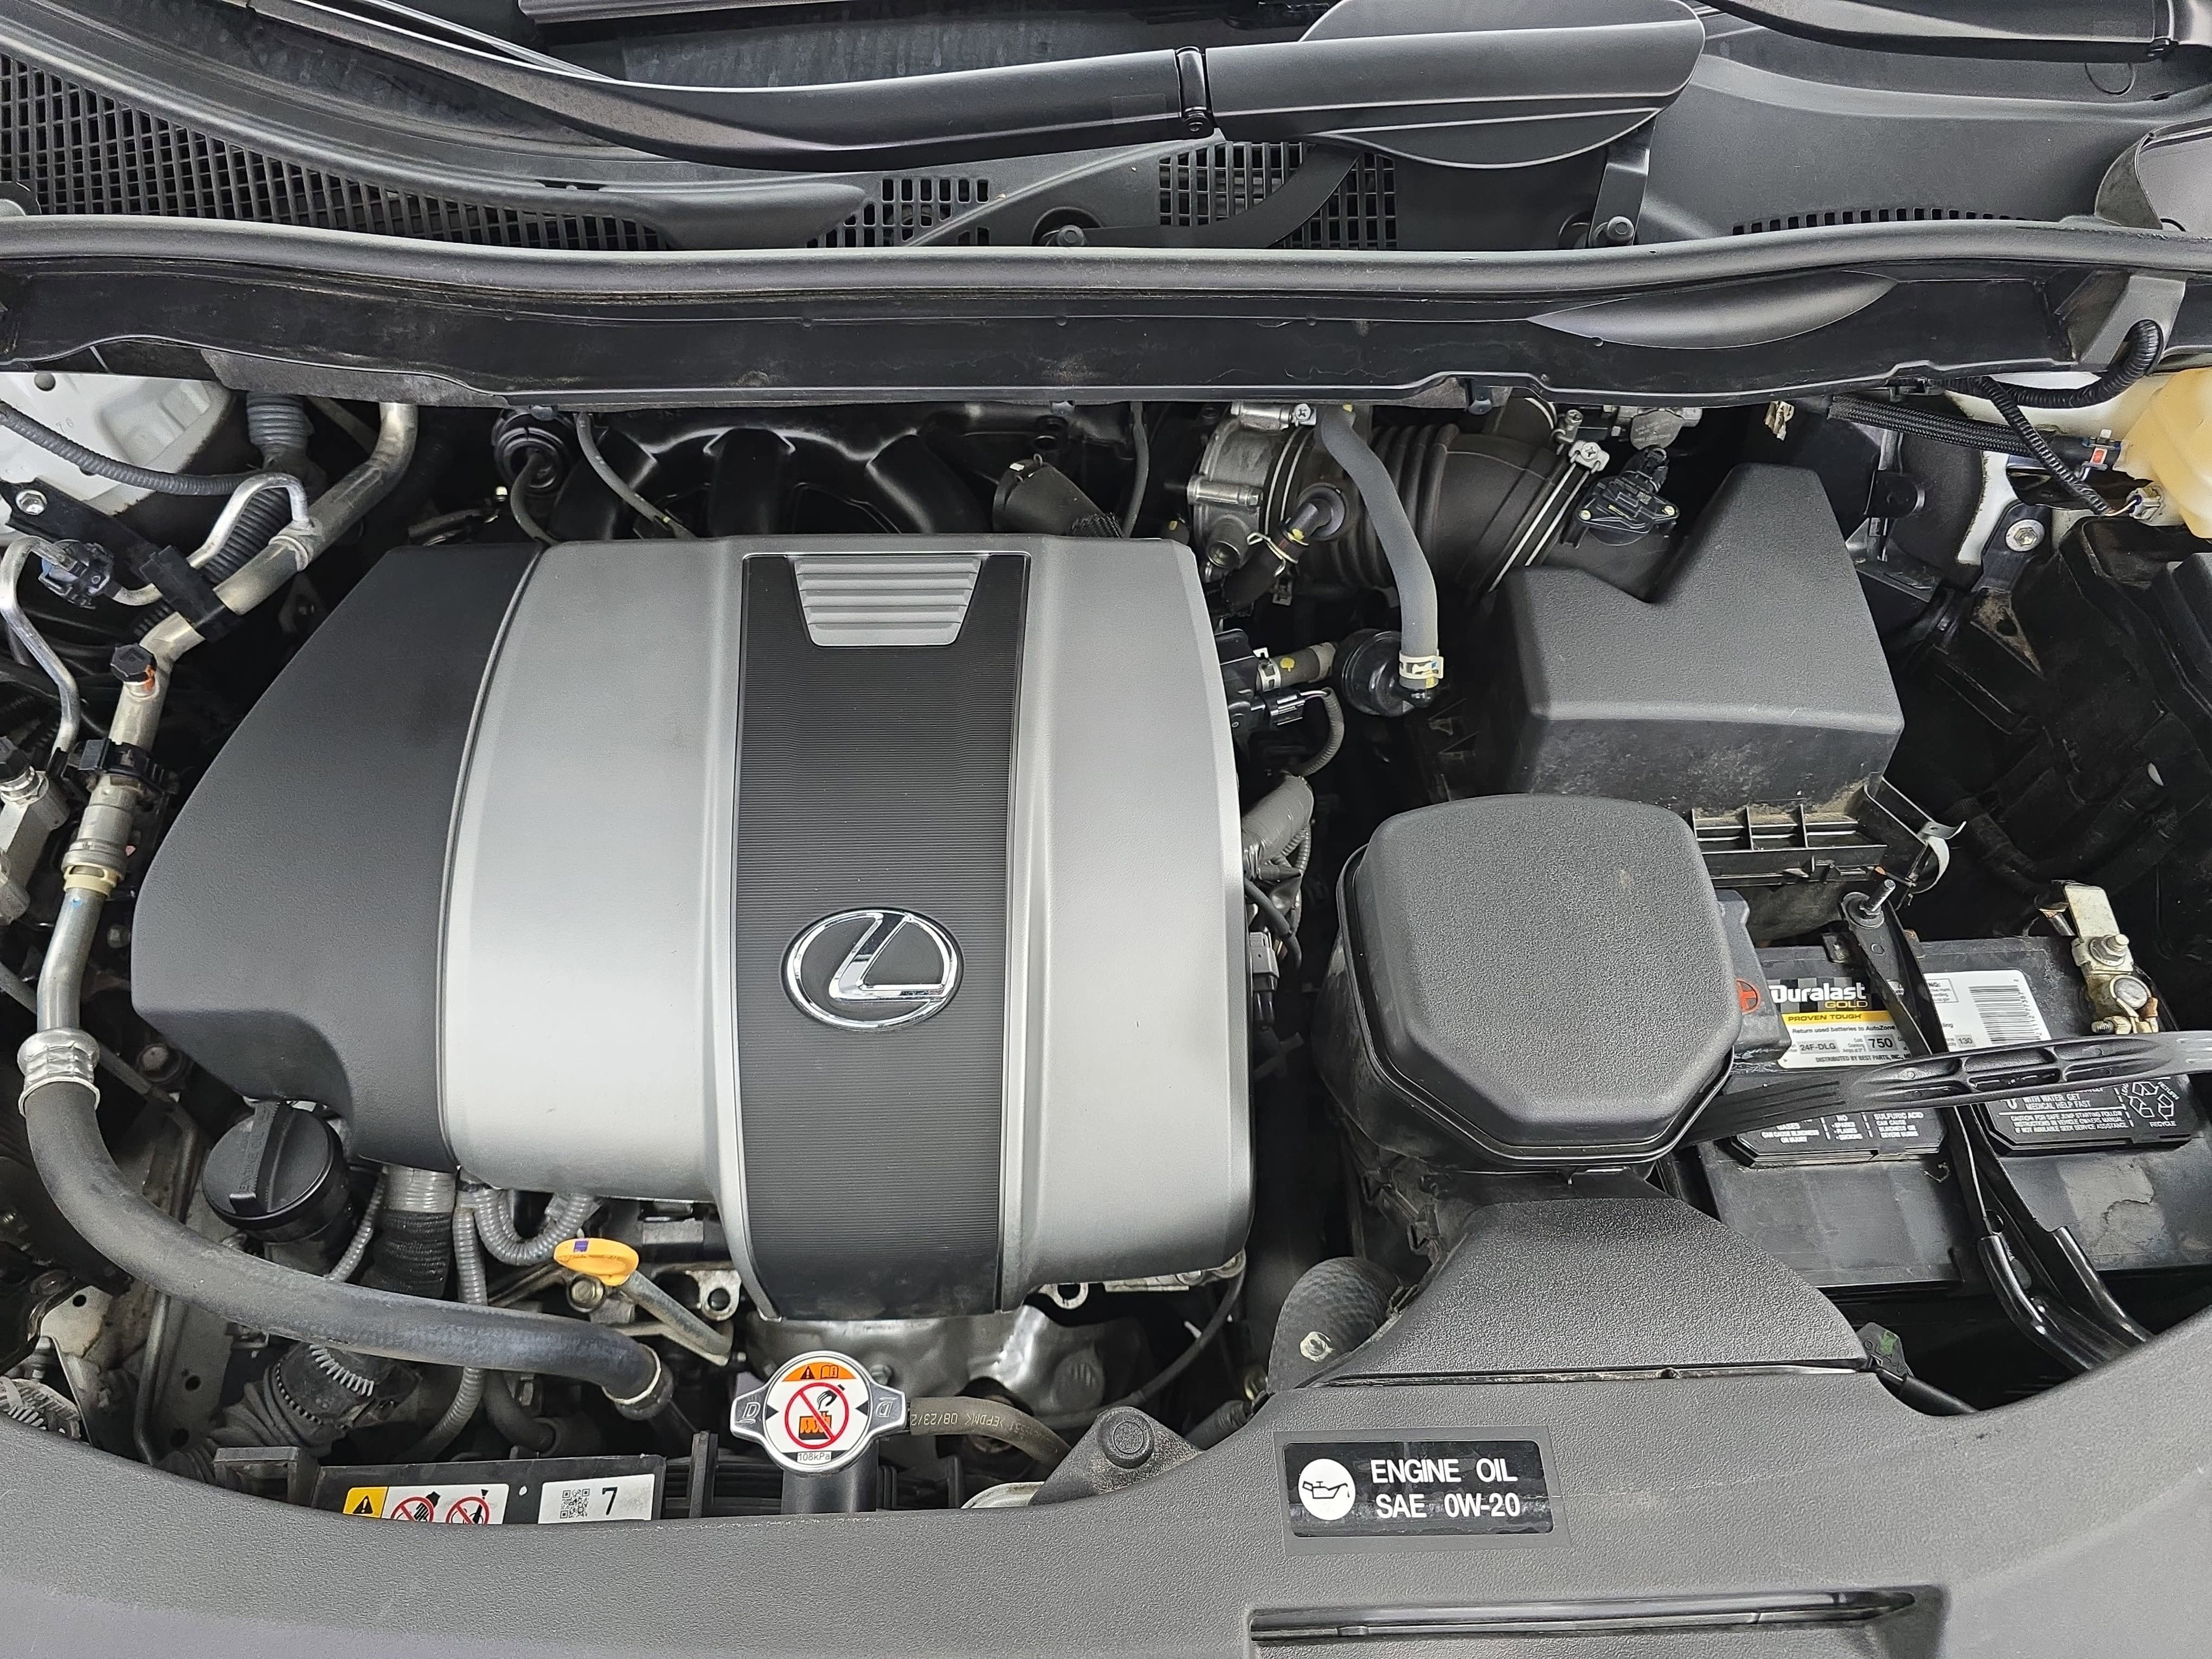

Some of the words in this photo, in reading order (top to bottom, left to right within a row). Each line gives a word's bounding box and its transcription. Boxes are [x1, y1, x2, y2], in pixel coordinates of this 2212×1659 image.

[1769, 982, 1866, 1003] Duralast
[1824, 1000, 1868, 1009] GOLD
[1799, 1043, 1836, 1051] 24F-DLG
[1868, 1038, 1893, 1049] 750
[798, 1452, 831, 1461] 108kPa
[1370, 1458, 1461, 1483] ENGINE
[1476, 1457, 1518, 1483] OIL
[602, 1486, 618, 1516] 7
[1375, 1494, 1427, 1519] SAE
[1444, 1492, 1521, 1517] 0W-20
